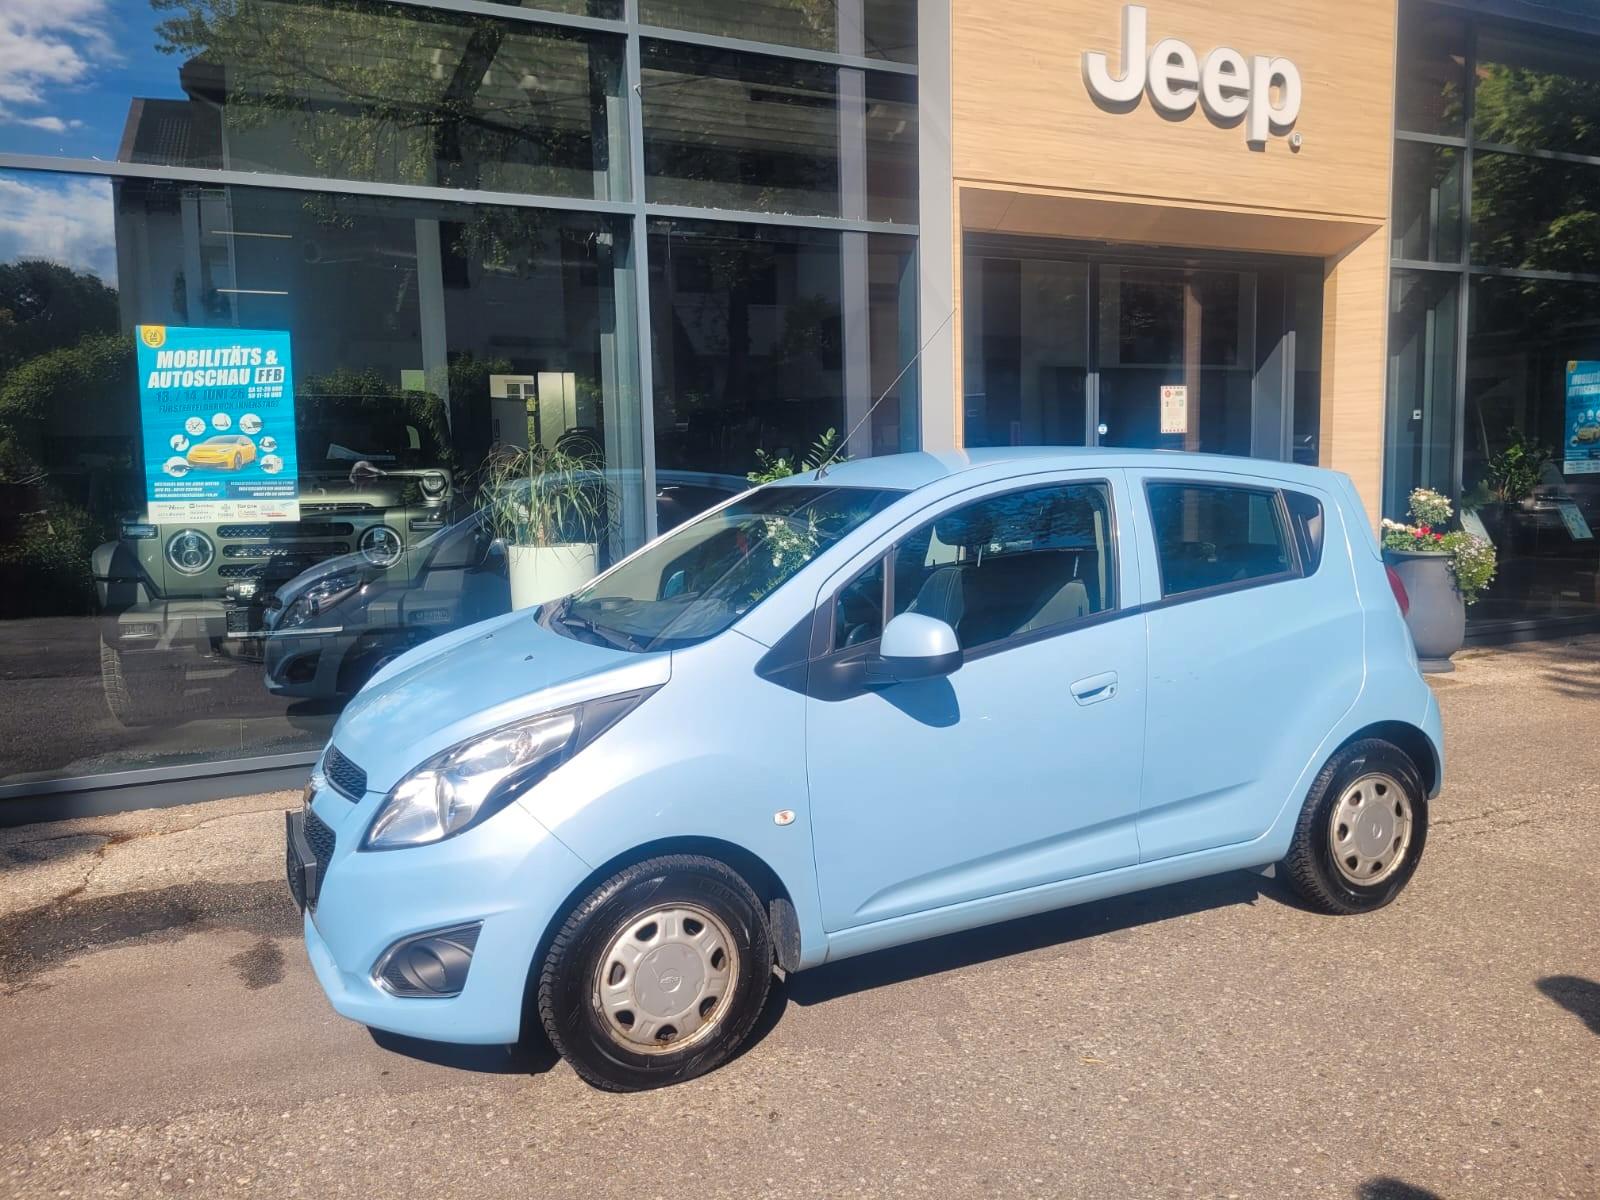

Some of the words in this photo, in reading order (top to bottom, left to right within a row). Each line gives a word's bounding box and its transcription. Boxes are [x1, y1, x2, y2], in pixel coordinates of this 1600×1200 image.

[1083, 5, 1302, 142] Jeep
[157, 345, 262, 368] MOBILITÄTS
[265, 350, 278, 365] &
[147, 368, 251, 388] AUTOSCHAU
[258, 368, 283, 382] FFB
